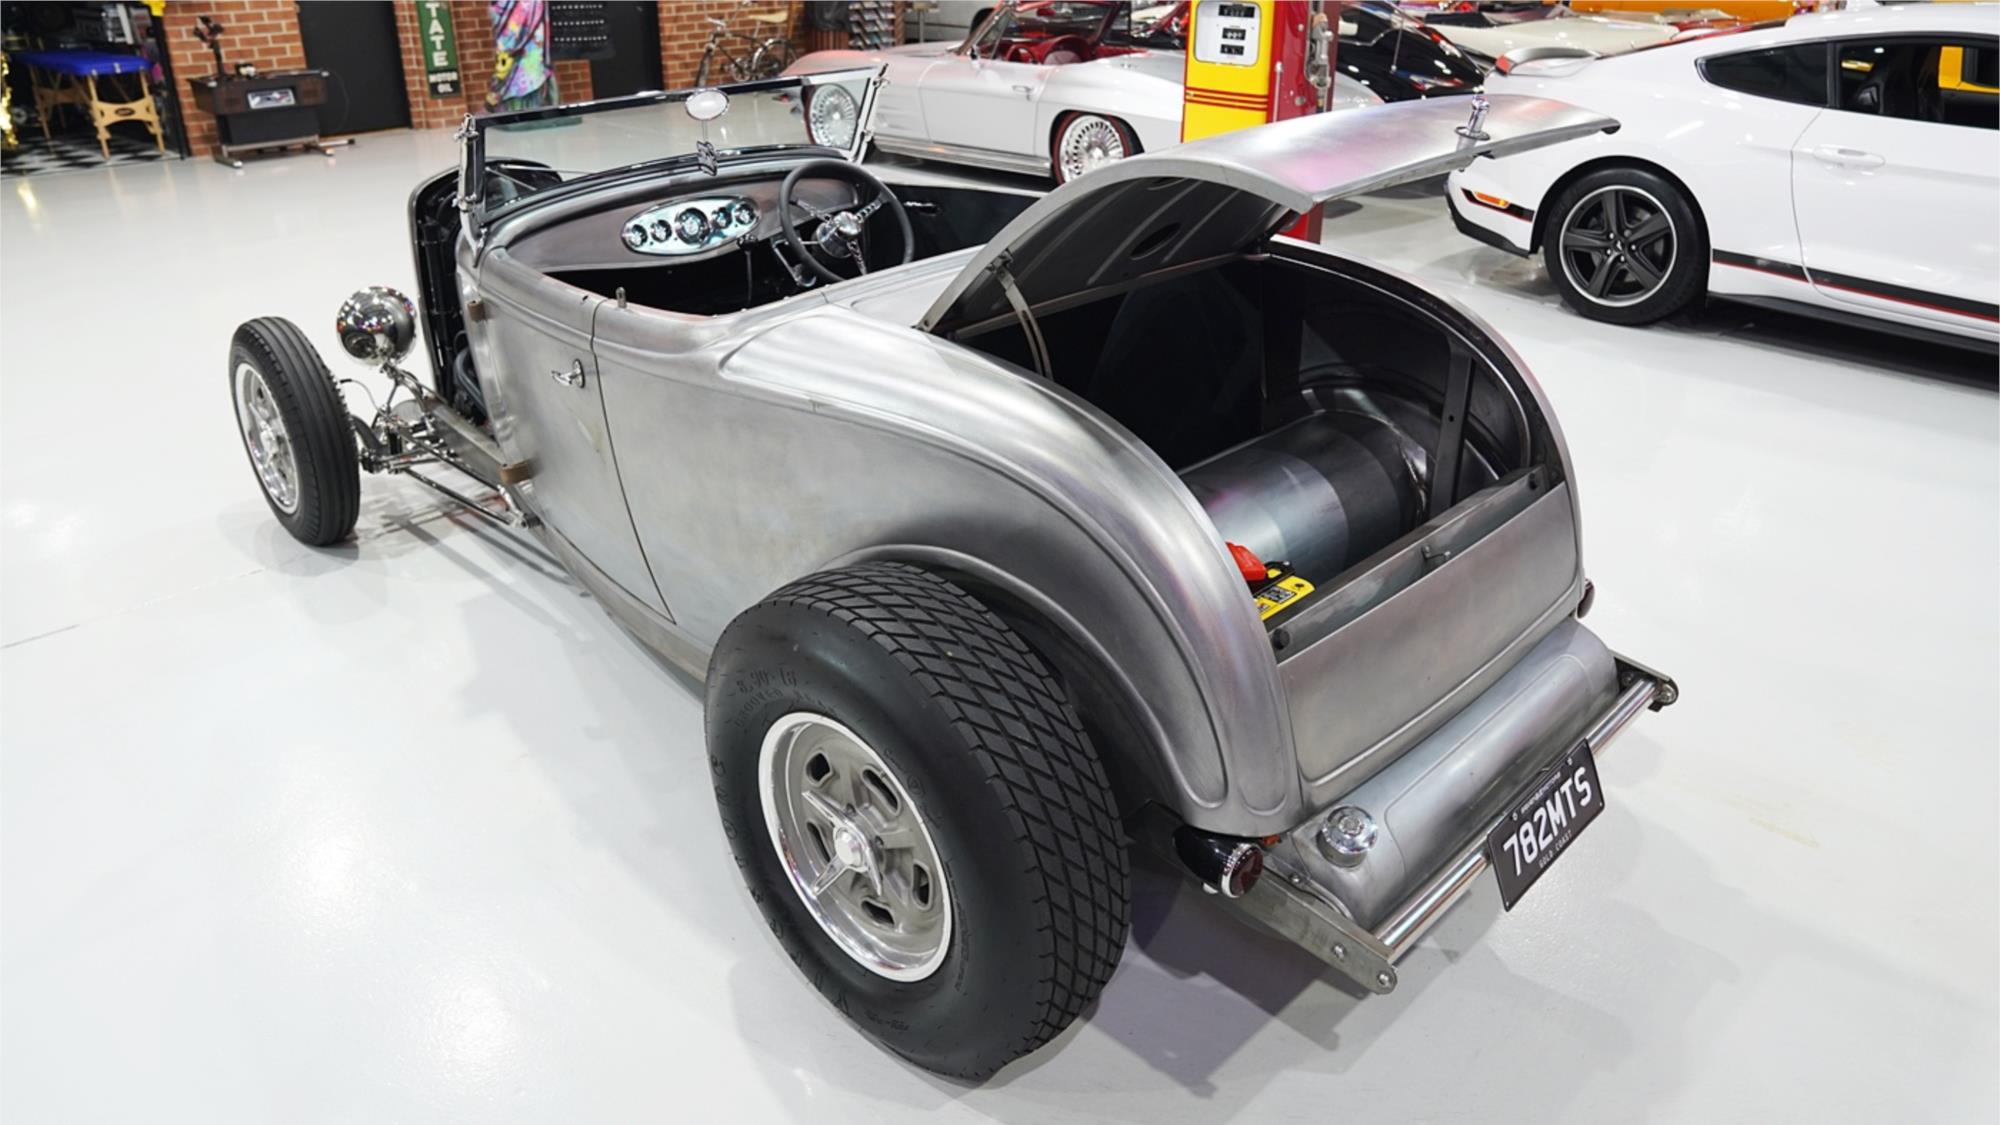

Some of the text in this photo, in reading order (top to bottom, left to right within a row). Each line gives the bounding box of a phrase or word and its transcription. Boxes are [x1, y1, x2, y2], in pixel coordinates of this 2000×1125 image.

[1503, 766, 1592, 876] 782MTS
[1538, 829, 1573, 868] GOLD COAST
